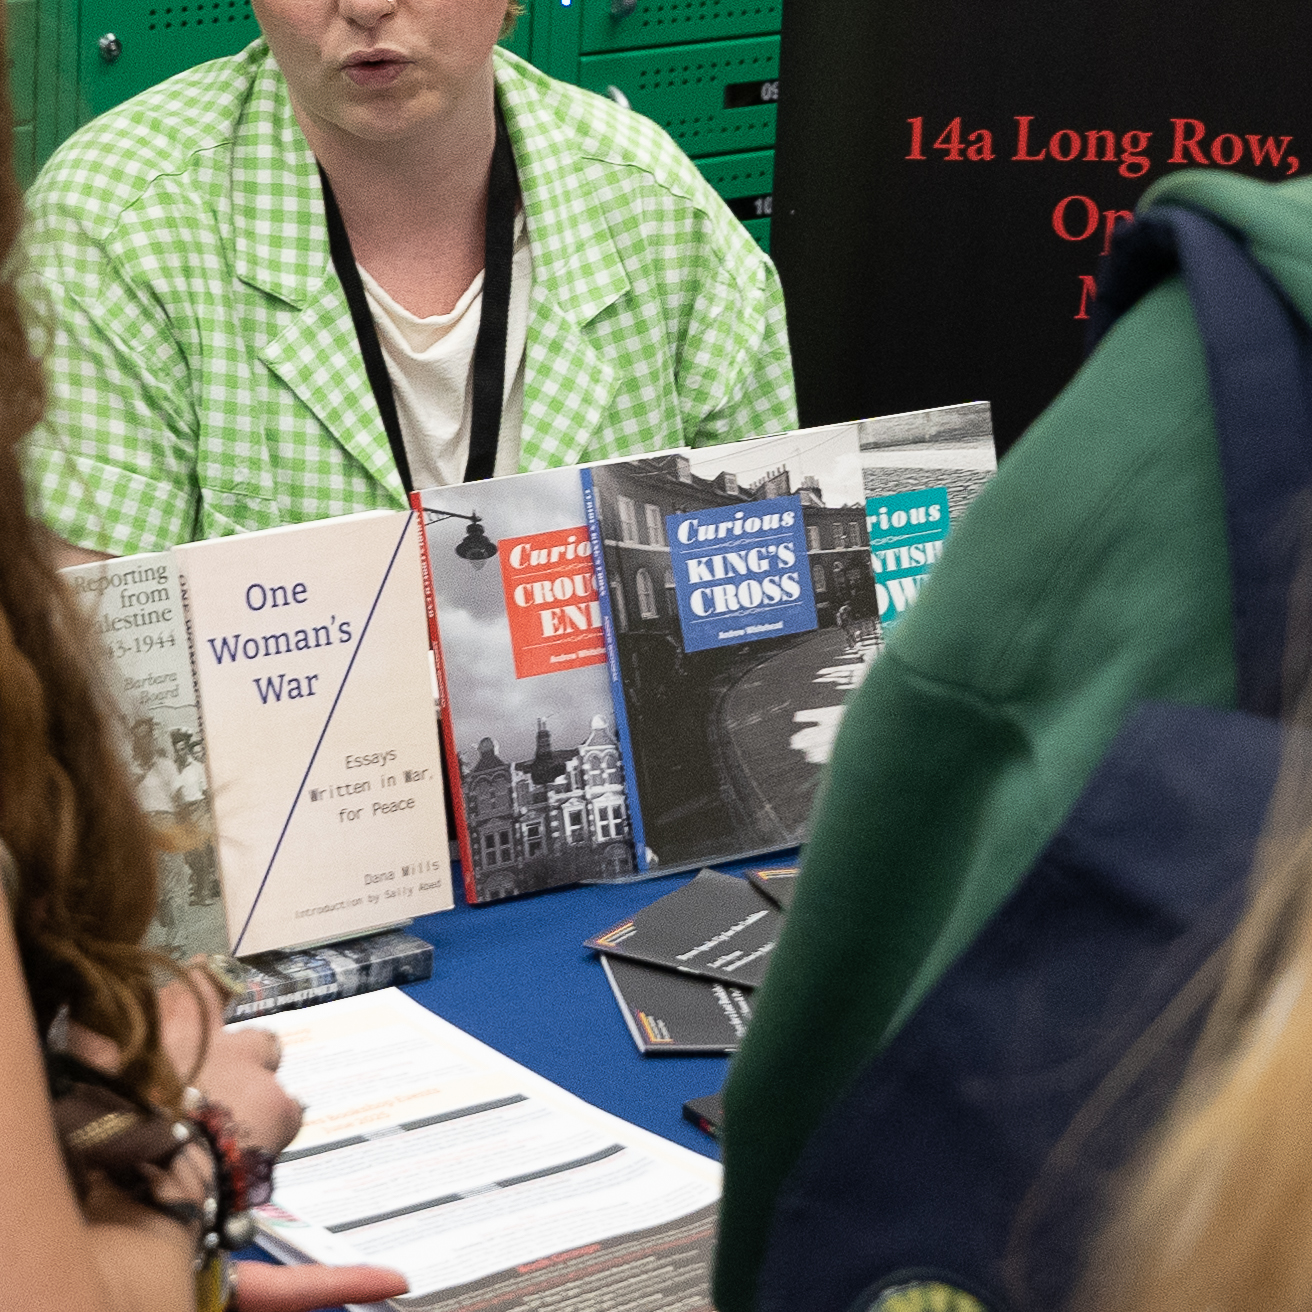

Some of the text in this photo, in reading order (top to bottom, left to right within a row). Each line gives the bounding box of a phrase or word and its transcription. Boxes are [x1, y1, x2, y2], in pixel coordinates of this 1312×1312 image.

[904, 115, 995, 162] 14a
[1011, 115, 1154, 179] Long
[1167, 117, 1301, 175] Row,
[677, 510, 796, 546] Curious
[685, 542, 797, 584] KING'S
[74, 565, 169, 596] Reporting
[514, 573, 598, 608] CROU
[690, 572, 802, 617] CROSS
[121, 587, 170, 609] from
[245, 581, 308, 612] One
[207, 614, 353, 666] Woman's
[253, 673, 319, 705] War
[345, 749, 398, 770] Essays
[308, 780, 372, 803] Written
[381, 775, 397, 789] in
[339, 797, 416, 823] for Peace
[364, 861, 440, 886] Dana Mills
